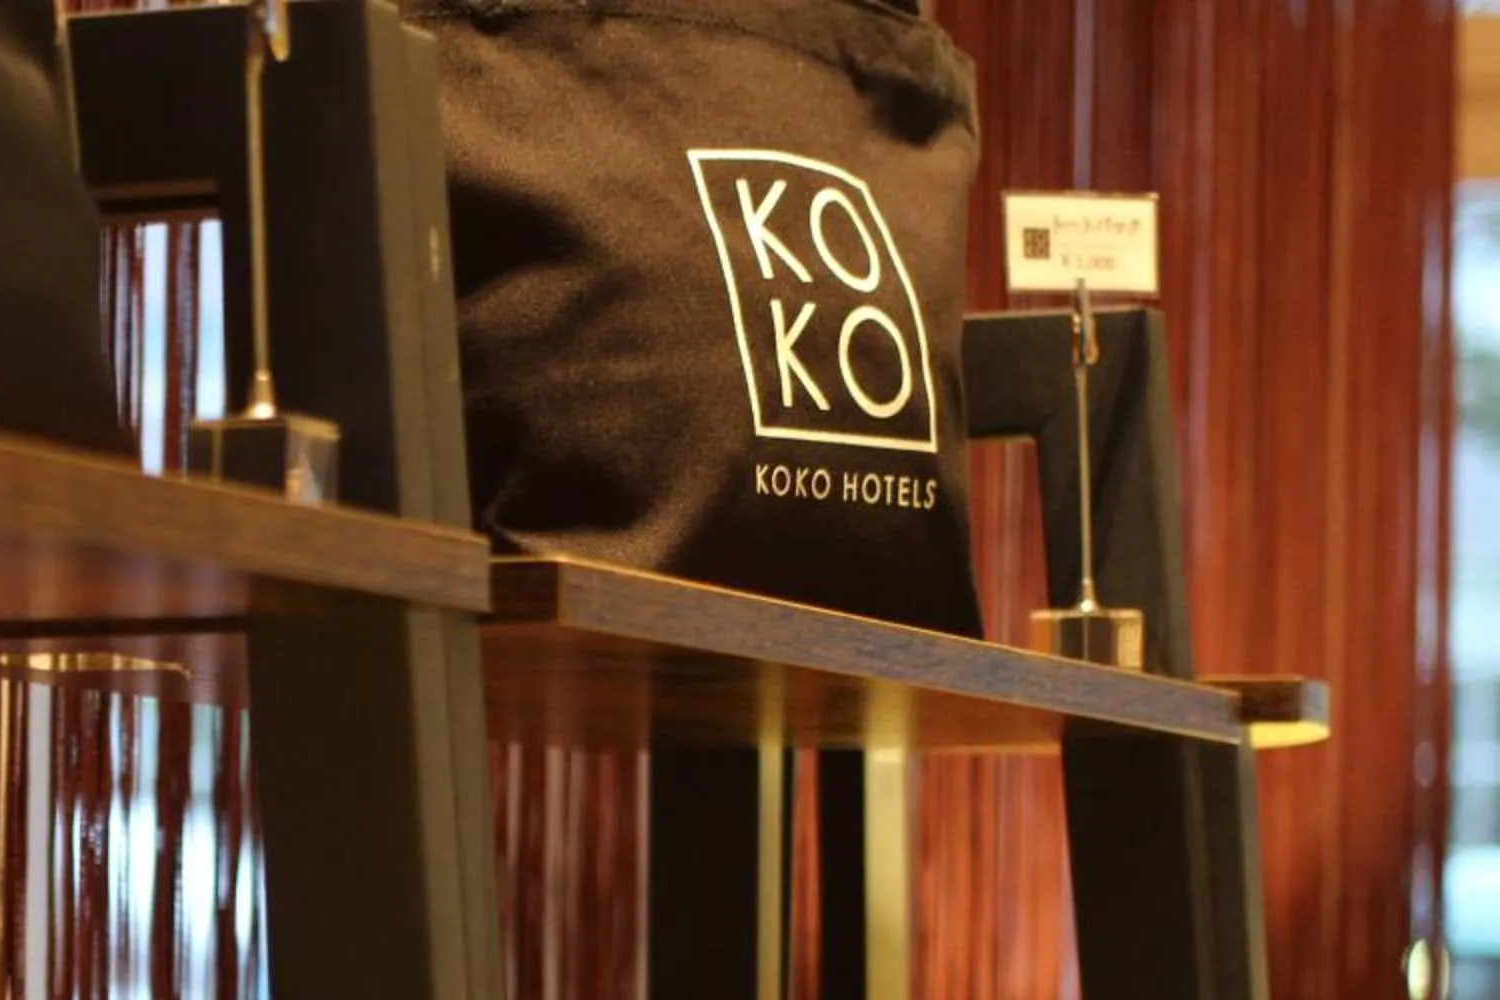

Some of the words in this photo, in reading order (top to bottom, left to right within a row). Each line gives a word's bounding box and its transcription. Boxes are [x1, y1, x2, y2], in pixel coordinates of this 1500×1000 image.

[736, 178, 880, 293] KO
[769, 299, 912, 419] KO
[755, 463, 831, 499] KOKO
[843, 472, 937, 510] HOTELS
